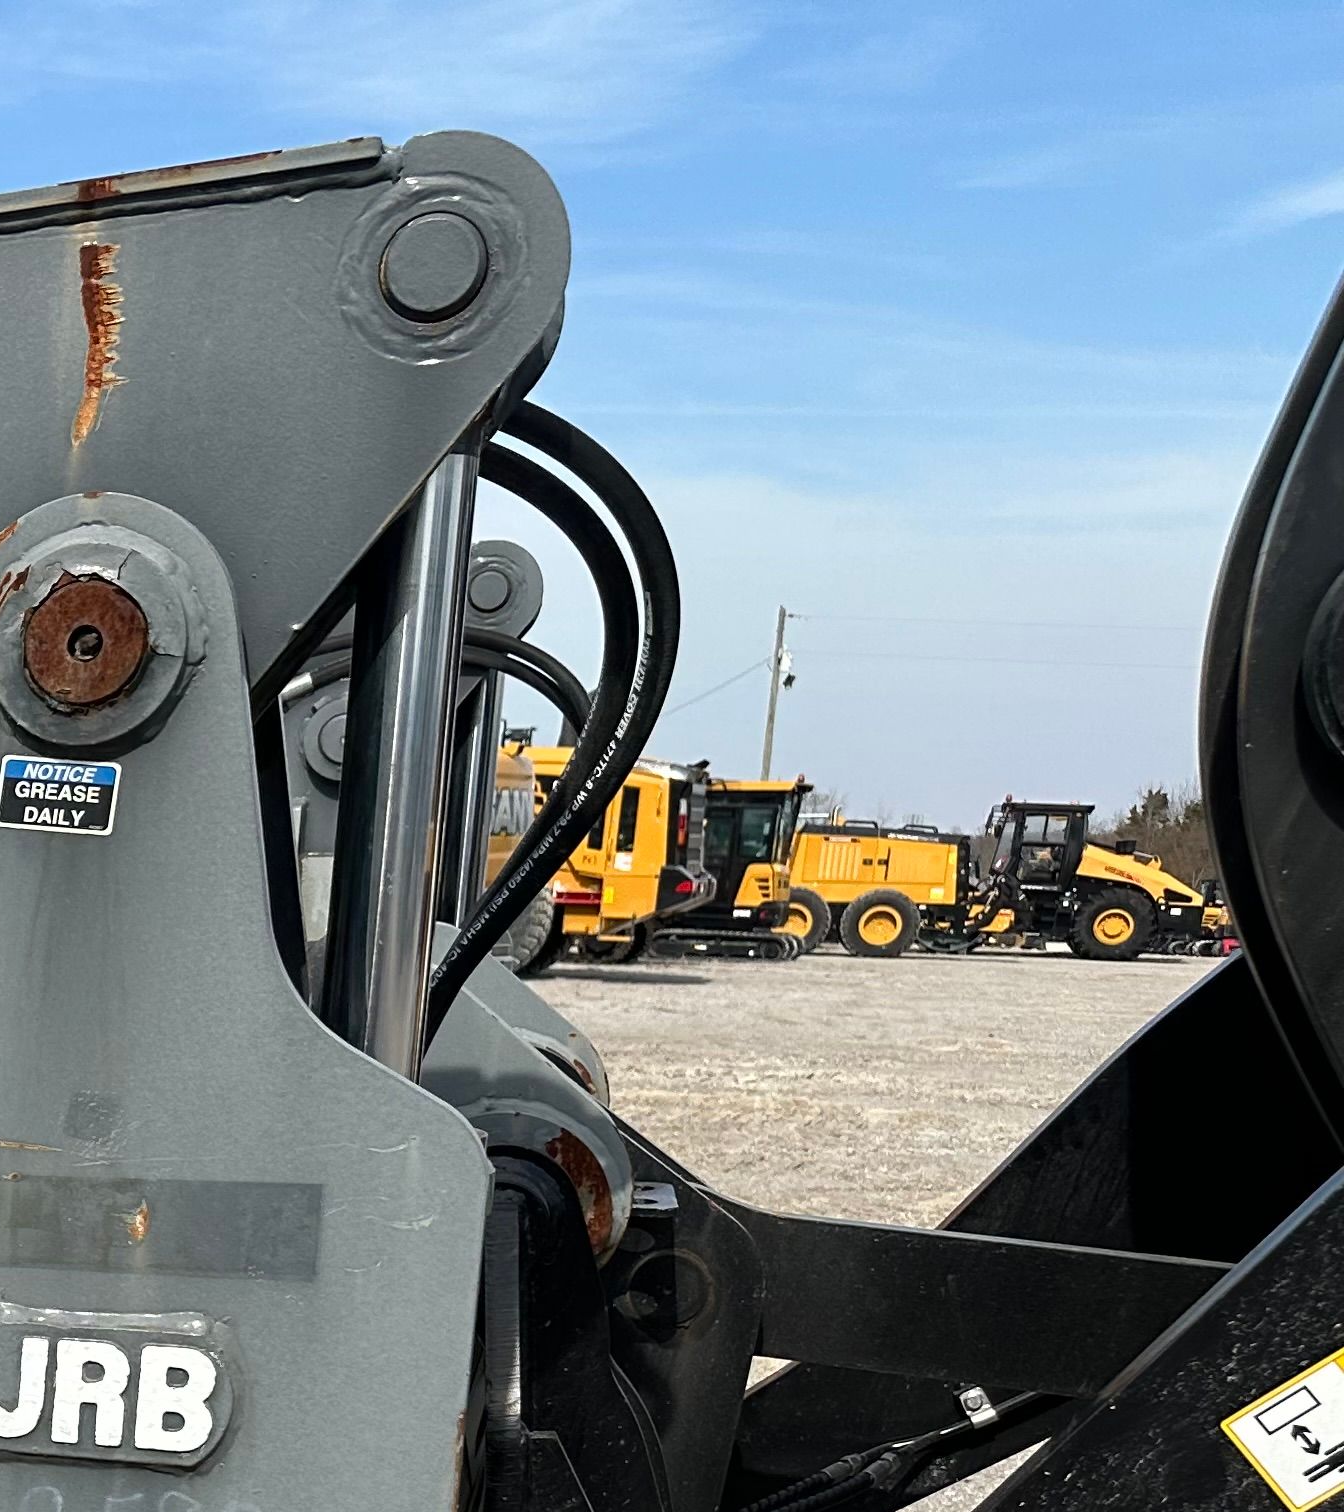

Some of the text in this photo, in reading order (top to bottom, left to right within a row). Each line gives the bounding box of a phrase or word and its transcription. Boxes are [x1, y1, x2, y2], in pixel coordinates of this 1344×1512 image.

[614, 693, 639, 738] COVER
[23, 764, 97, 783] NOTICE
[584, 740, 617, 789] 471TC-8
[14, 781, 101, 803] GREASE
[571, 790, 588, 811] WP
[23, 806, 85, 827] DAILY
[461, 912, 490, 945] MSHA
